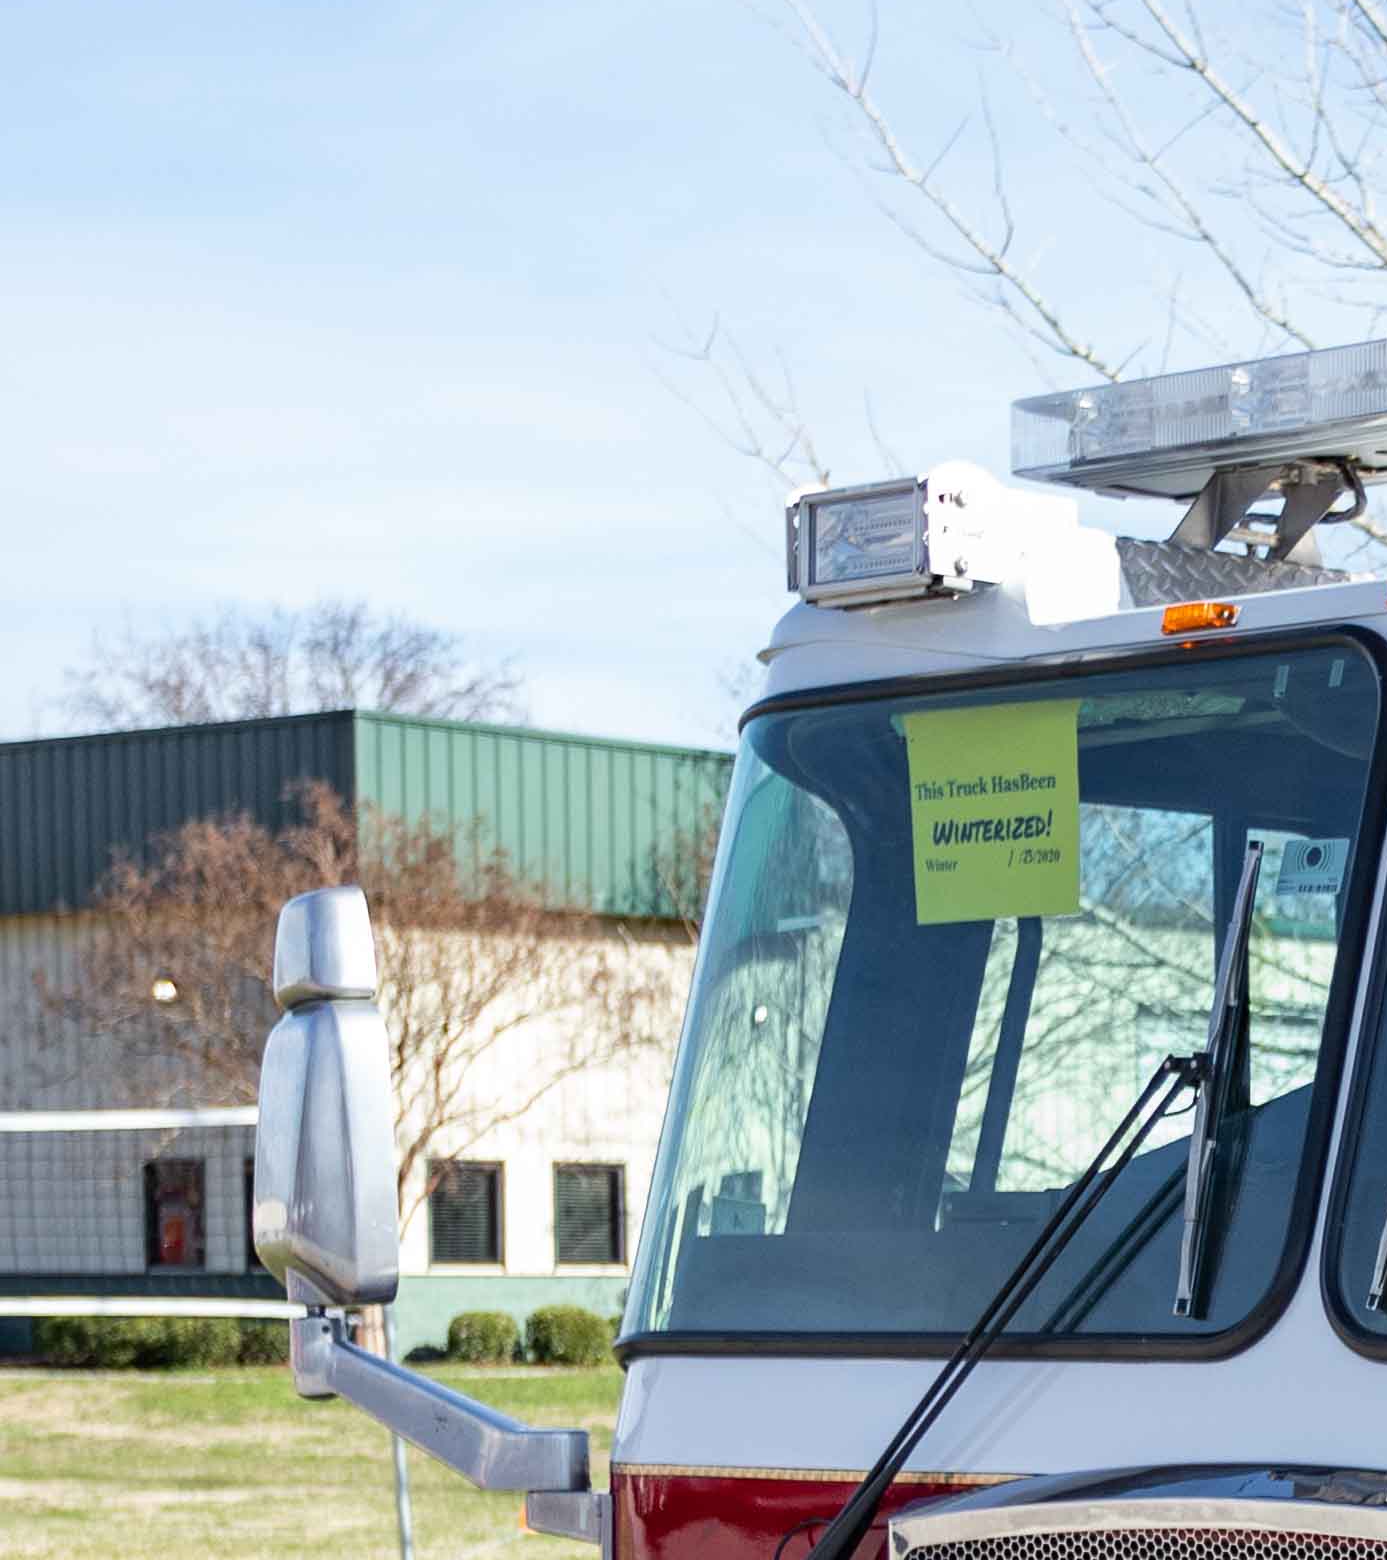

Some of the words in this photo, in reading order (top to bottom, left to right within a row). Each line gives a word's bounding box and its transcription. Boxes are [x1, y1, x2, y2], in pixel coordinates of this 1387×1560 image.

[915, 781, 944, 801] This
[947, 777, 986, 798] Truck
[934, 809, 1052, 845] WINTERIZED!
